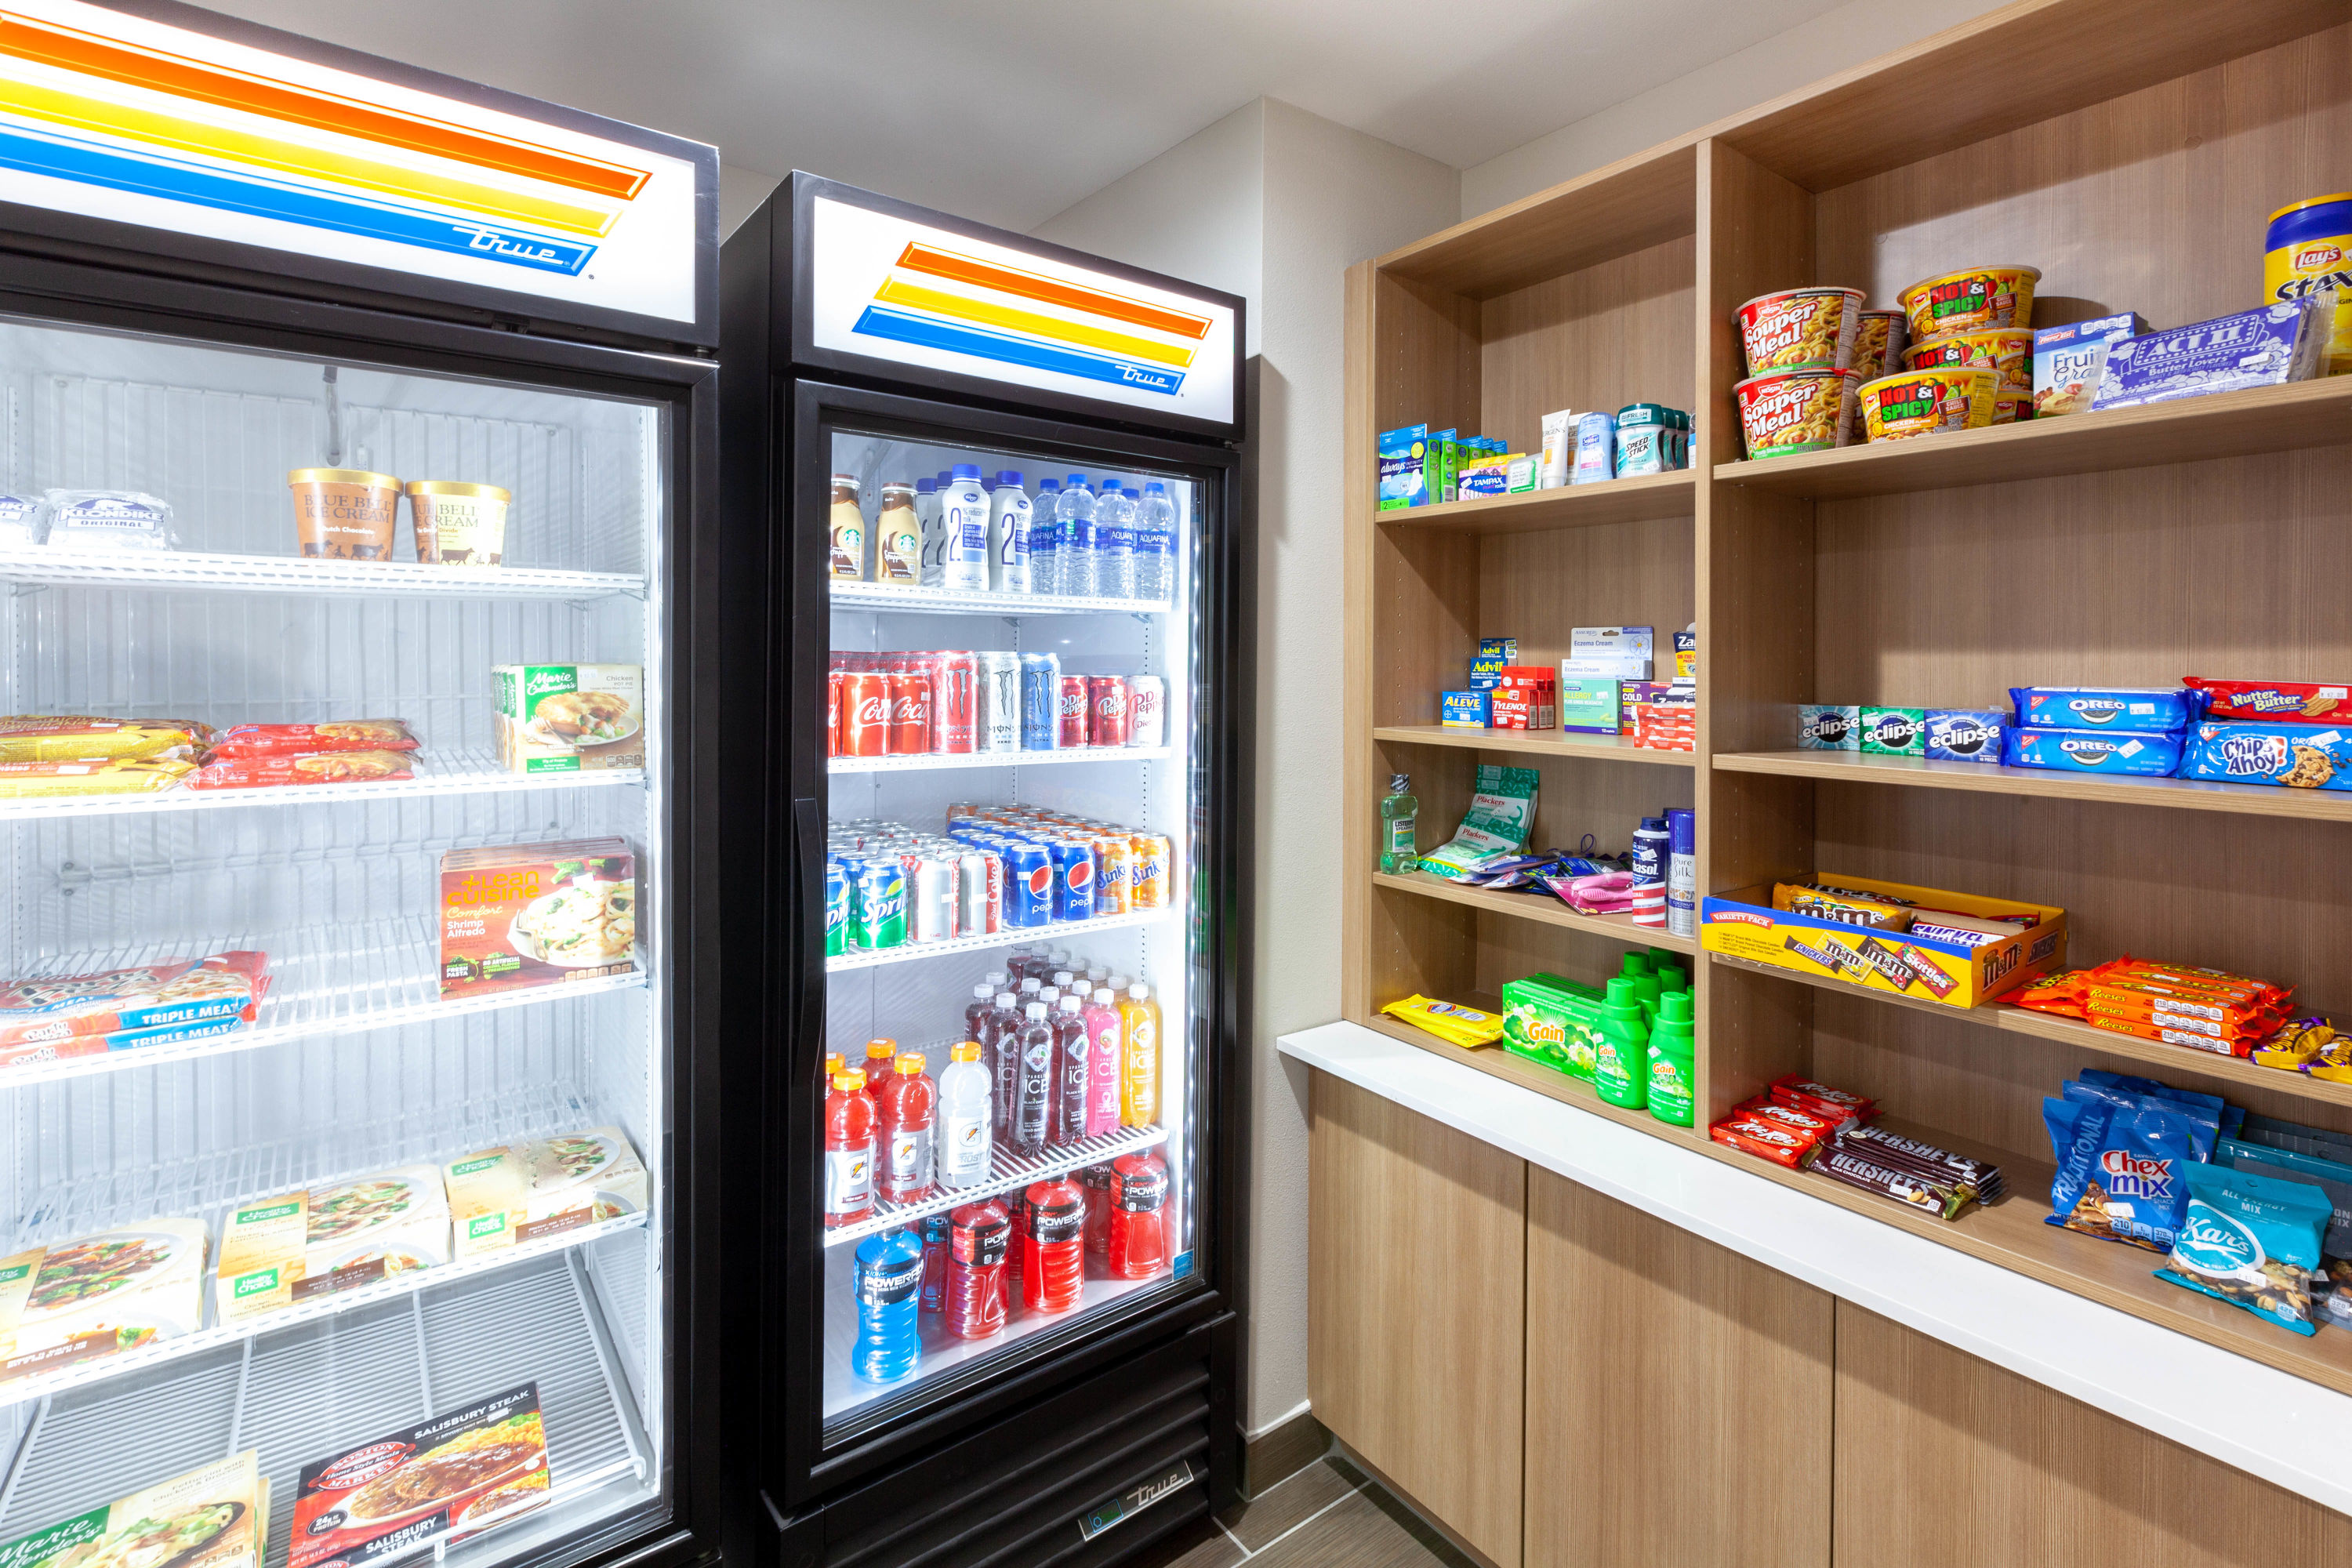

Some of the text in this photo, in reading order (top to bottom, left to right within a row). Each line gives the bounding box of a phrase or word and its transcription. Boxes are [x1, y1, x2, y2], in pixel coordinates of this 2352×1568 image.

[2297, 248, 2339, 269] Lay's
[1931, 281, 1985, 303] HOT &
[1933, 296, 1985, 318] SPICY
[1746, 303, 1816, 349] Souper
[1935, 315, 1967, 325] CHICKEN
[1752, 322, 1802, 361] Meal
[2146, 325, 2244, 357] ACT II
[1915, 347, 1959, 368] HOT &
[2149, 356, 2228, 376] Butter Lovers
[1880, 384, 1933, 406] HOT &
[1744, 385, 1817, 427] Souper
[1882, 400, 1933, 421] SPICY
[1946, 403, 1965, 412] SAUCE
[1751, 404, 1802, 441] Meal
[1884, 419, 1915, 430] CHICKEN
[1626, 437, 1649, 452] SPEED
[1628, 443, 1649, 458] STICK
[1381, 461, 1406, 474] always
[1473, 477, 1503, 487] TAMPAX
[354, 496, 390, 512] BELL
[58, 507, 164, 522] KLONDIKE
[333, 507, 389, 524] CREAM
[1001, 513, 1015, 565] 2
[1139, 534, 1170, 545] AQUAFINA
[1472, 662, 1504, 672] Advil
[528, 673, 572, 686] Marie
[526, 682, 576, 695] Callender's
[1444, 696, 1480, 707] ALEVE
[2069, 700, 2126, 711] OREO
[2231, 690, 2277, 706] Nutter
[2255, 696, 2299, 711] Butter
[1494, 701, 1527, 711] TYLENOL
[1802, 717, 1860, 738] eclipse
[1864, 720, 1924, 742] eclipse
[1929, 726, 1999, 748] eclipse
[2060, 740, 2118, 752] OREO
[1476, 796, 1505, 806] Plackers
[1462, 828, 1489, 841] Plackers
[1674, 857, 1692, 866] Pure
[482, 870, 539, 888] Lean
[987, 866, 1000, 903] Coke
[447, 906, 503, 919] Comfort
[1713, 912, 1769, 927] VARIETY PACK
[447, 920, 484, 929] Shrimp
[447, 928, 485, 938] Alfredo
[1796, 943, 1833, 965] SNICKERS
[1904, 953, 1948, 989] Skittles
[2089, 989, 2126, 1002] Reese's
[142, 1003, 239, 1025] TRIPLE MEAT
[2087, 1002, 2124, 1015] Reese's
[1528, 1022, 1565, 1043] Gain
[2097, 1018, 2133, 1033] Reese's
[129, 1033, 184, 1048] TRIPLE
[1599, 1045, 1616, 1056] Gain
[1653, 1063, 1675, 1074] Gain
[1024, 1080, 1050, 1094] ICE
[1860, 1125, 1981, 1171] HERSHEY'S
[1899, 1147, 1934, 1162] CHOCOLATE
[2050, 1113, 2106, 1203] TRADITIONAL
[2103, 1151, 2170, 1176] Chex
[1830, 1154, 1933, 1196] HERSHEY'S
[1843, 1170, 1871, 1183] CHOCOLATE
[2113, 1174, 2170, 1197] mix
[2222, 1189, 2239, 1200] ALL
[241, 1209, 292, 1222] Choice
[249, 1204, 291, 1216] Healthy
[2241, 1203, 2261, 1214] MIX
[475, 1216, 500, 1228] Healthy
[2114, 1219, 2129, 1229] 210
[471, 1225, 503, 1236] Choice
[2182, 1216, 2249, 1252] Kar's
[242, 1272, 273, 1287] Healthy
[237, 1281, 276, 1294] Choice
[2279, 1305, 2293, 1314] 420
[2330, 1298, 2346, 1308] 320
[414, 1389, 528, 1440] SALISBURY STEAK
[332, 1442, 396, 1471] BOSTON
[326, 1450, 401, 1480] Home Style Meals
[328, 1460, 396, 1488] MARKET
[314, 1518, 341, 1533] PROTEIN
[365, 1516, 437, 1555] SALISBURY
